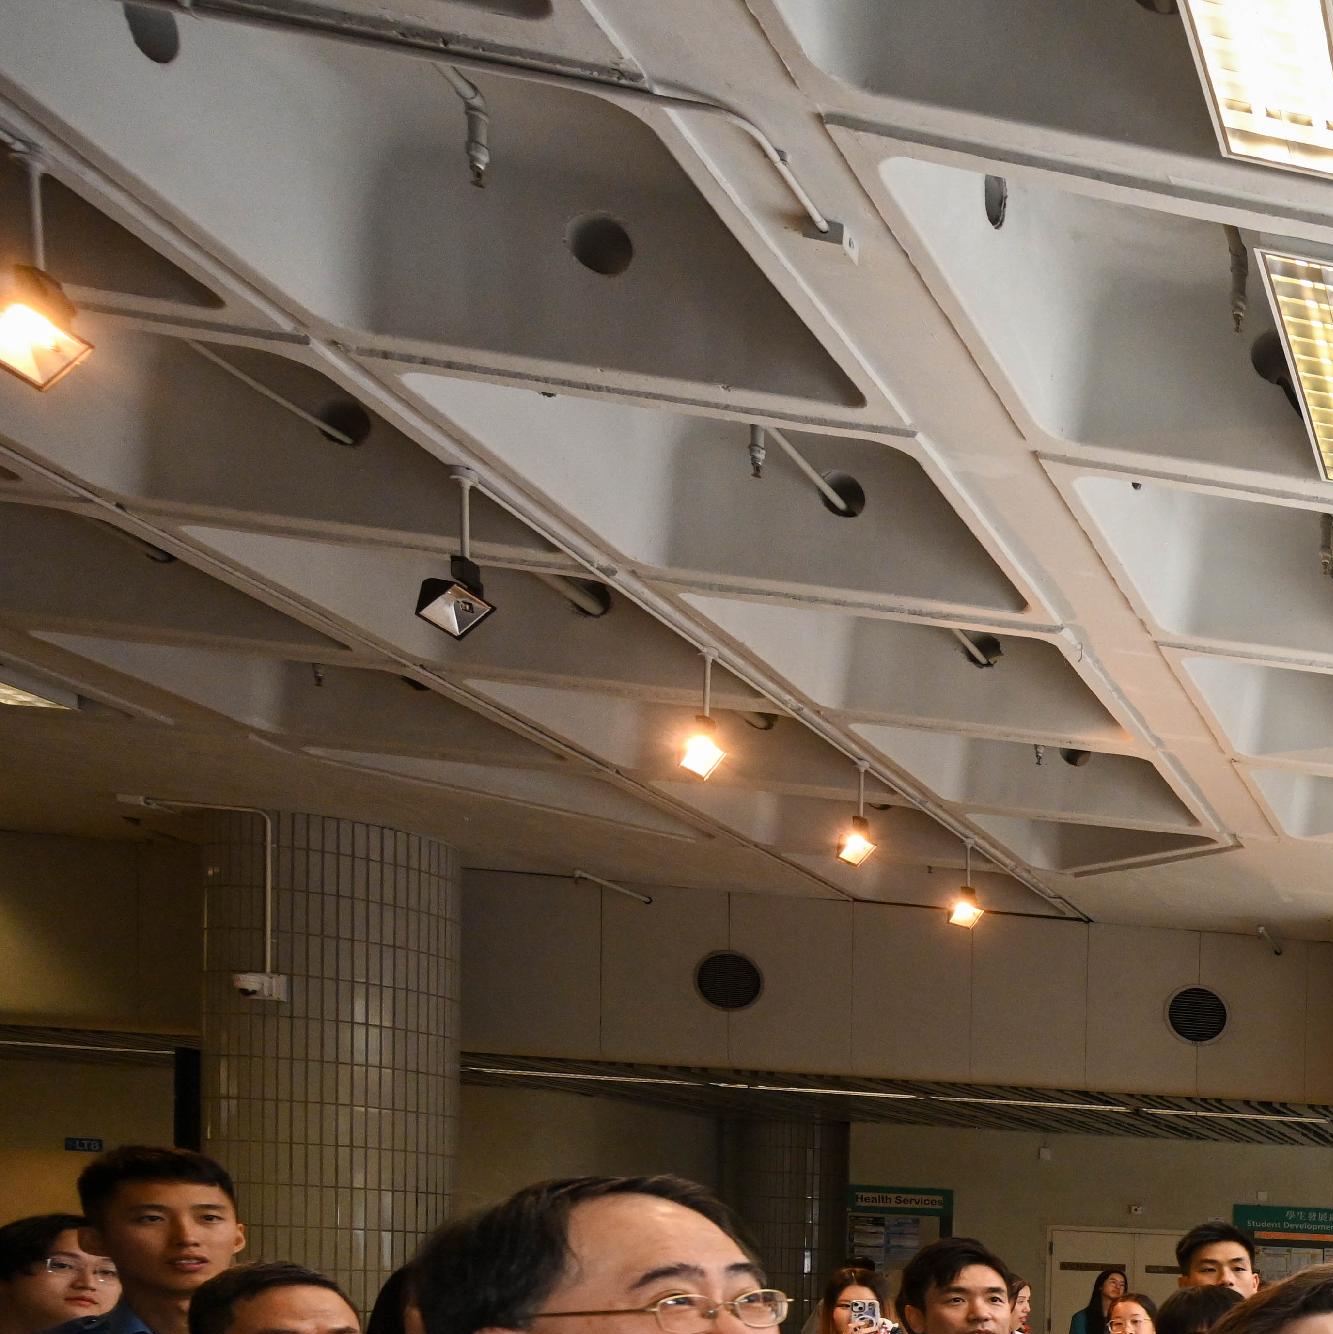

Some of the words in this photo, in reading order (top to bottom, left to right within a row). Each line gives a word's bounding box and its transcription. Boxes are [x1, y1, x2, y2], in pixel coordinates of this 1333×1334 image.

[856, 1194, 892, 1204] Health
[894, 1196, 944, 1206] Services
[1248, 1220, 1280, 1228] Student
